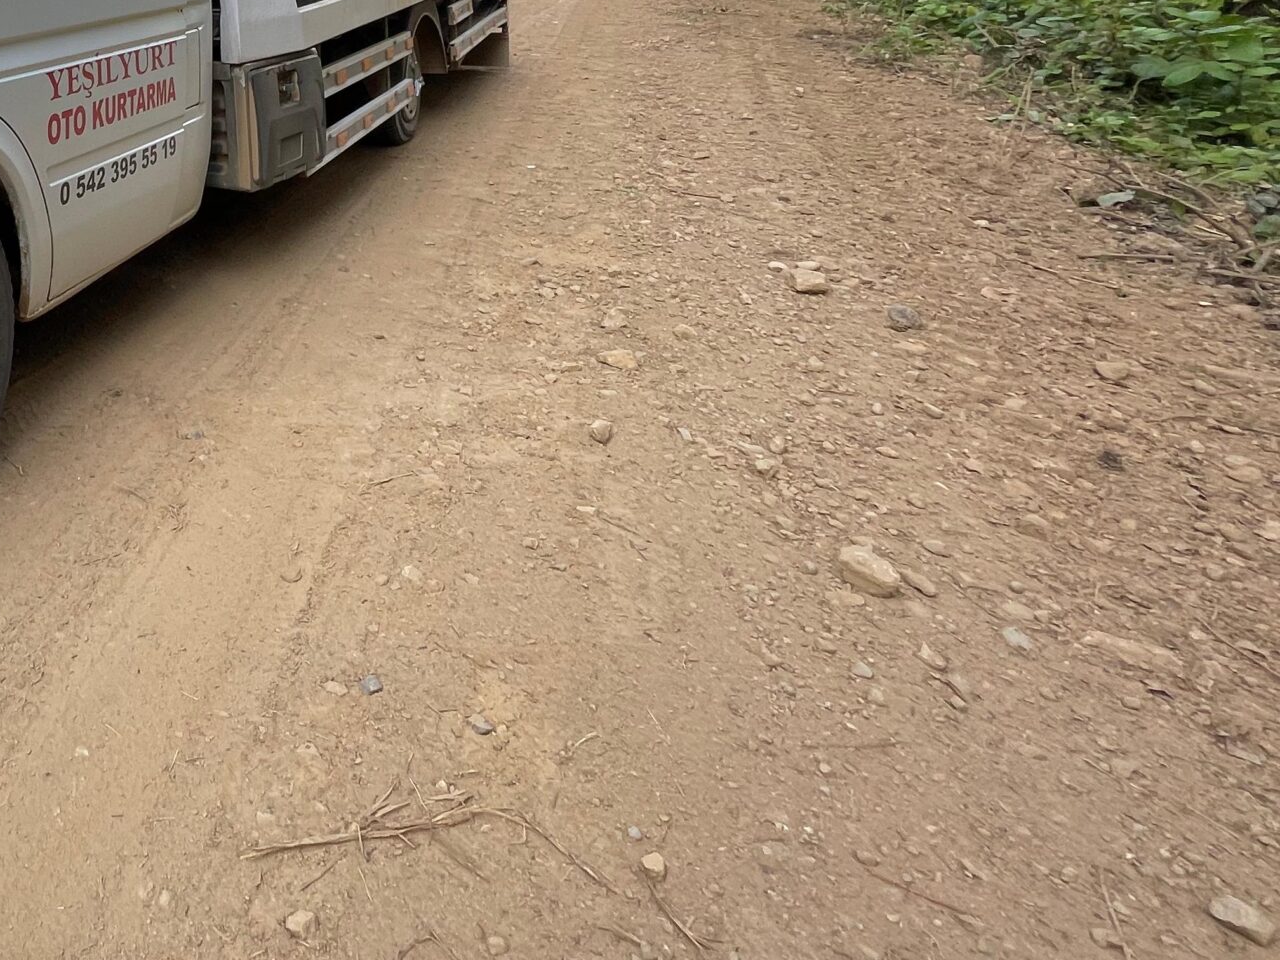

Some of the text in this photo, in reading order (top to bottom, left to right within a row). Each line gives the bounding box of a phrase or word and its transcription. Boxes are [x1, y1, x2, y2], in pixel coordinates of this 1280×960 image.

[46, 41, 177, 101] YEŞİLYURT
[47, 77, 177, 145] OTO KURTARMA
[60, 136, 177, 206] 0 542 395 55 19
